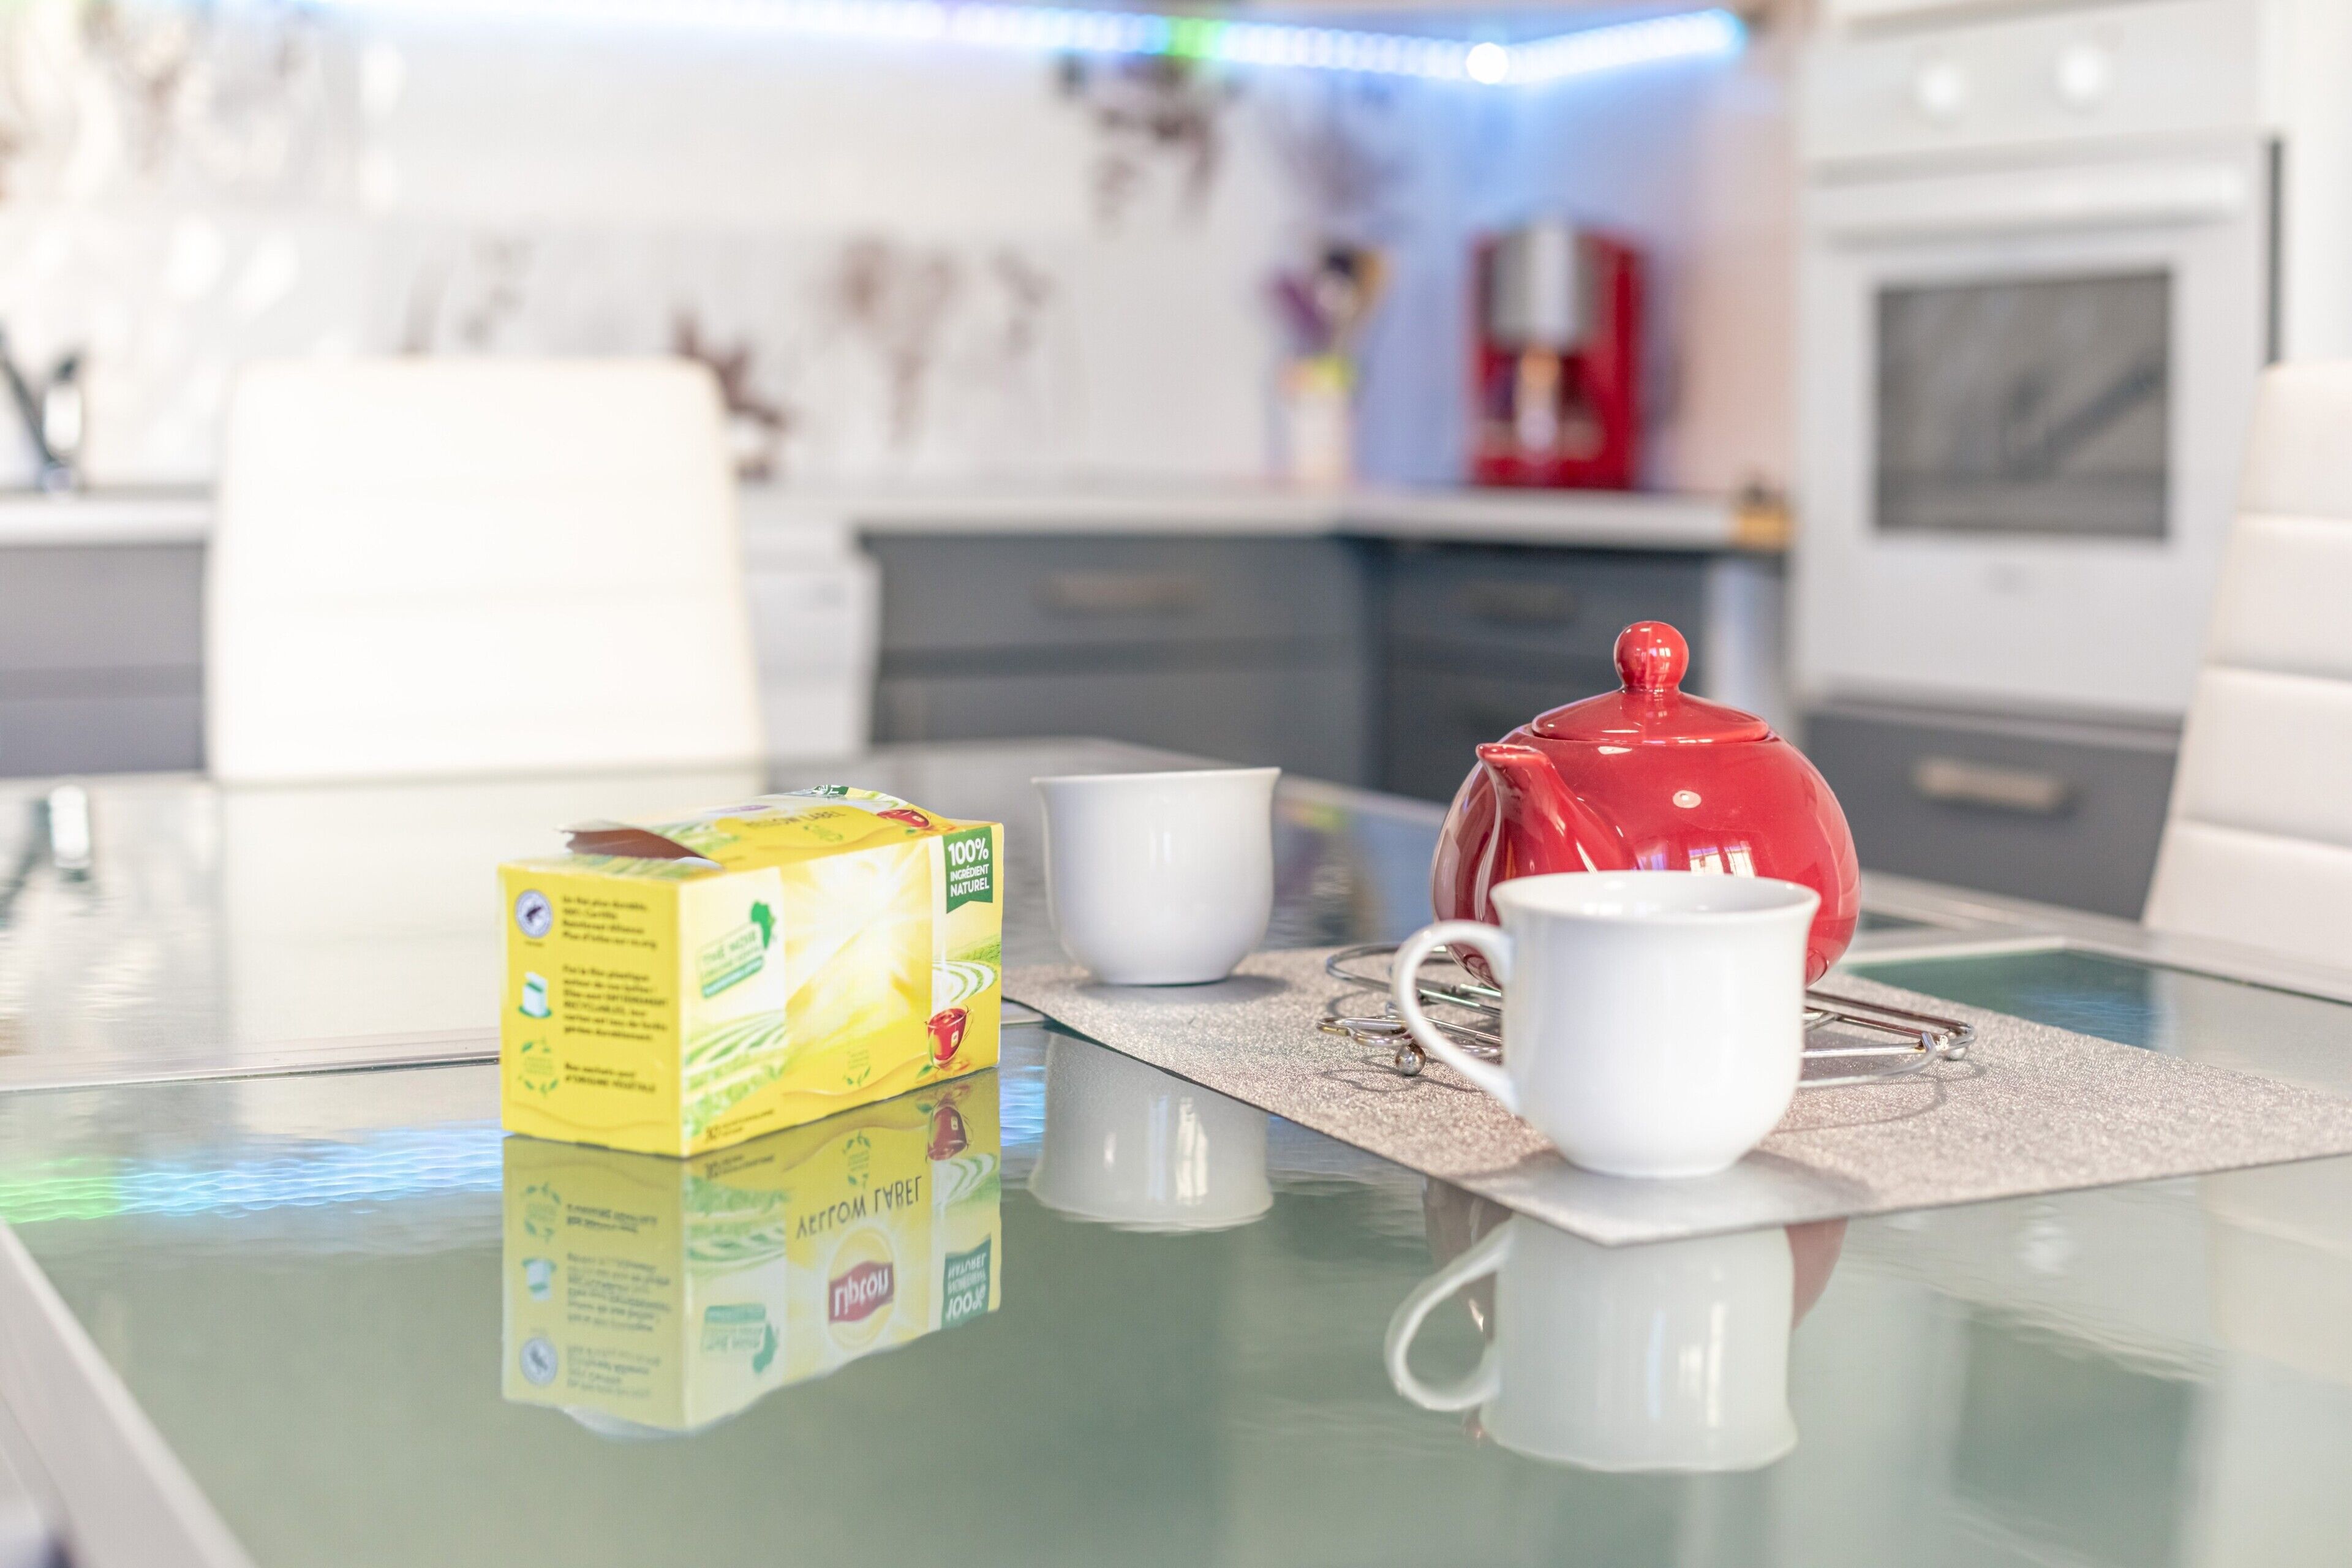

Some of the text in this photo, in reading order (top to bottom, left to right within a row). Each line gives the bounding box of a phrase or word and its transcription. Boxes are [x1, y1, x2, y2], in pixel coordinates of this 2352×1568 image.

[948, 837, 989, 866] 100%
[950, 864, 989, 881] INGRÉDIENT
[950, 877, 990, 897] NATUREL
